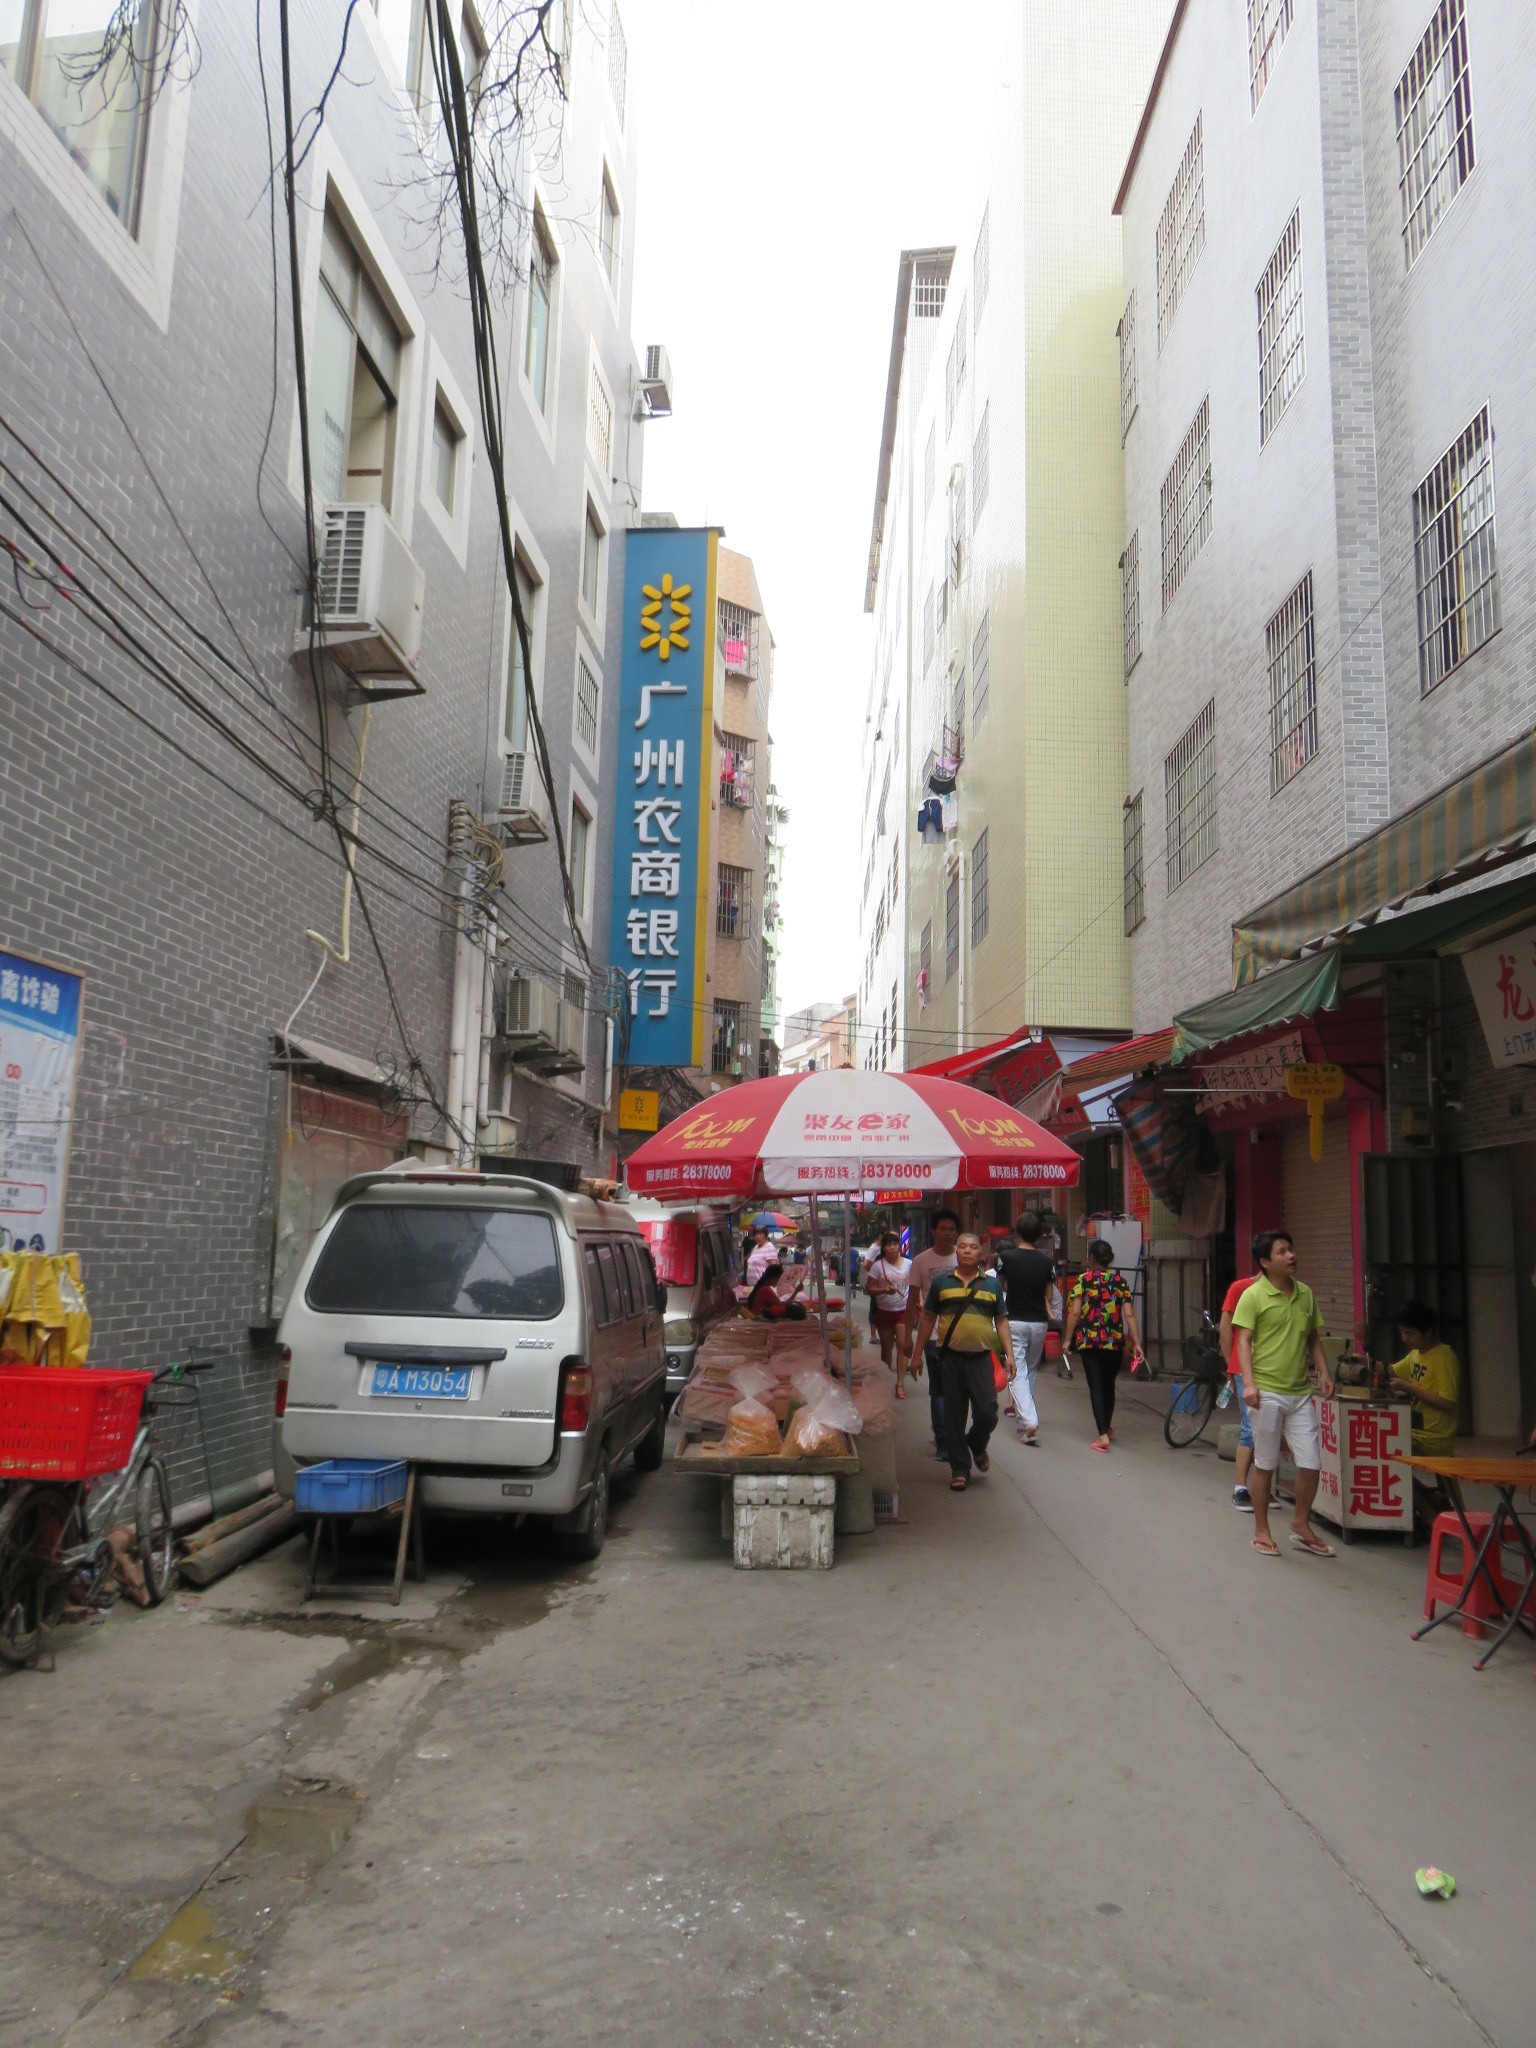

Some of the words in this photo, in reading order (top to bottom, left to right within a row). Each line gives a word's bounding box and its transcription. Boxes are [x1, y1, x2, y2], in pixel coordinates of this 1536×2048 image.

[626, 680, 688, 1019] 广州农商银行
[663, 1111, 758, 1146] 100M
[803, 1112, 910, 1131] 聚友e家
[946, 1108, 1024, 1144] 100M
[682, 1164, 732, 1180] 28378000
[861, 1163, 932, 1178] 28378000
[1022, 1164, 1066, 1179] 28378000
[1347, 1409, 1404, 1518] 配匙
